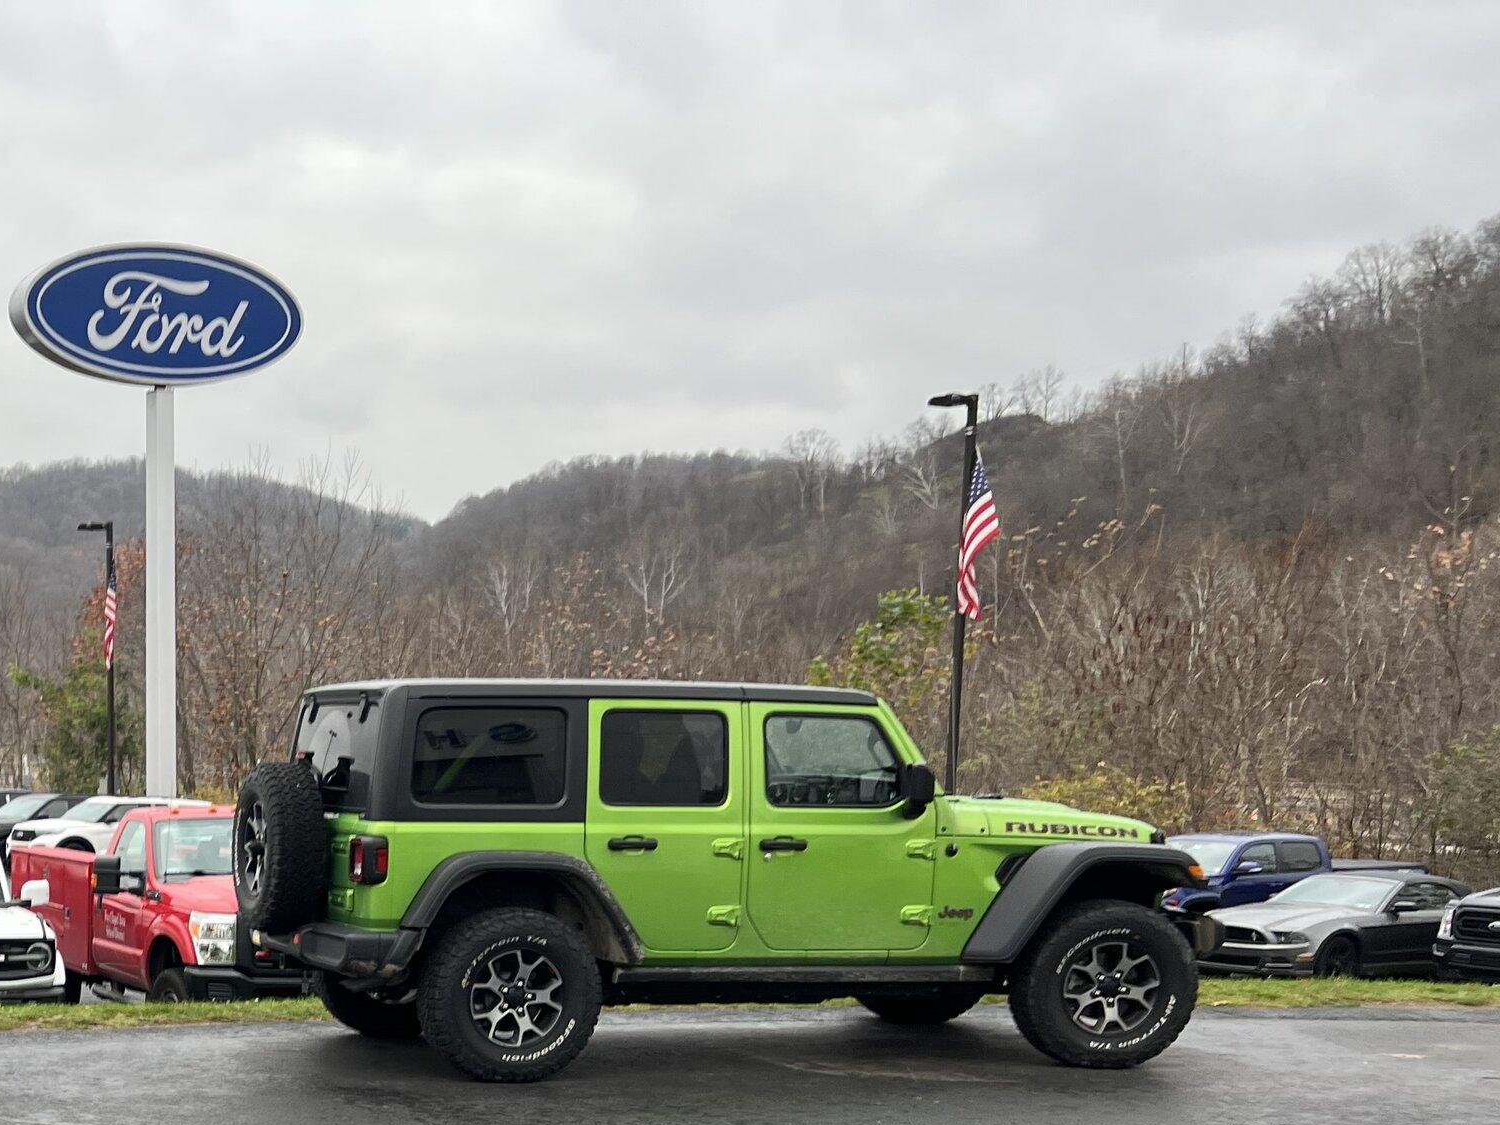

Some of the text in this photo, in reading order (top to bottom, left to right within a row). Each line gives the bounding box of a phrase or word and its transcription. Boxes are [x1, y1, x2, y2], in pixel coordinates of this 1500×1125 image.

[87, 271, 249, 357] Ford
[1005, 822, 1138, 838] RUBICON
[938, 905, 973, 921] Jeep
[527, 935, 547, 946] T/A
[502, 1018, 576, 1062] BFGoodrich
[1090, 1040, 1112, 1050] T/A
